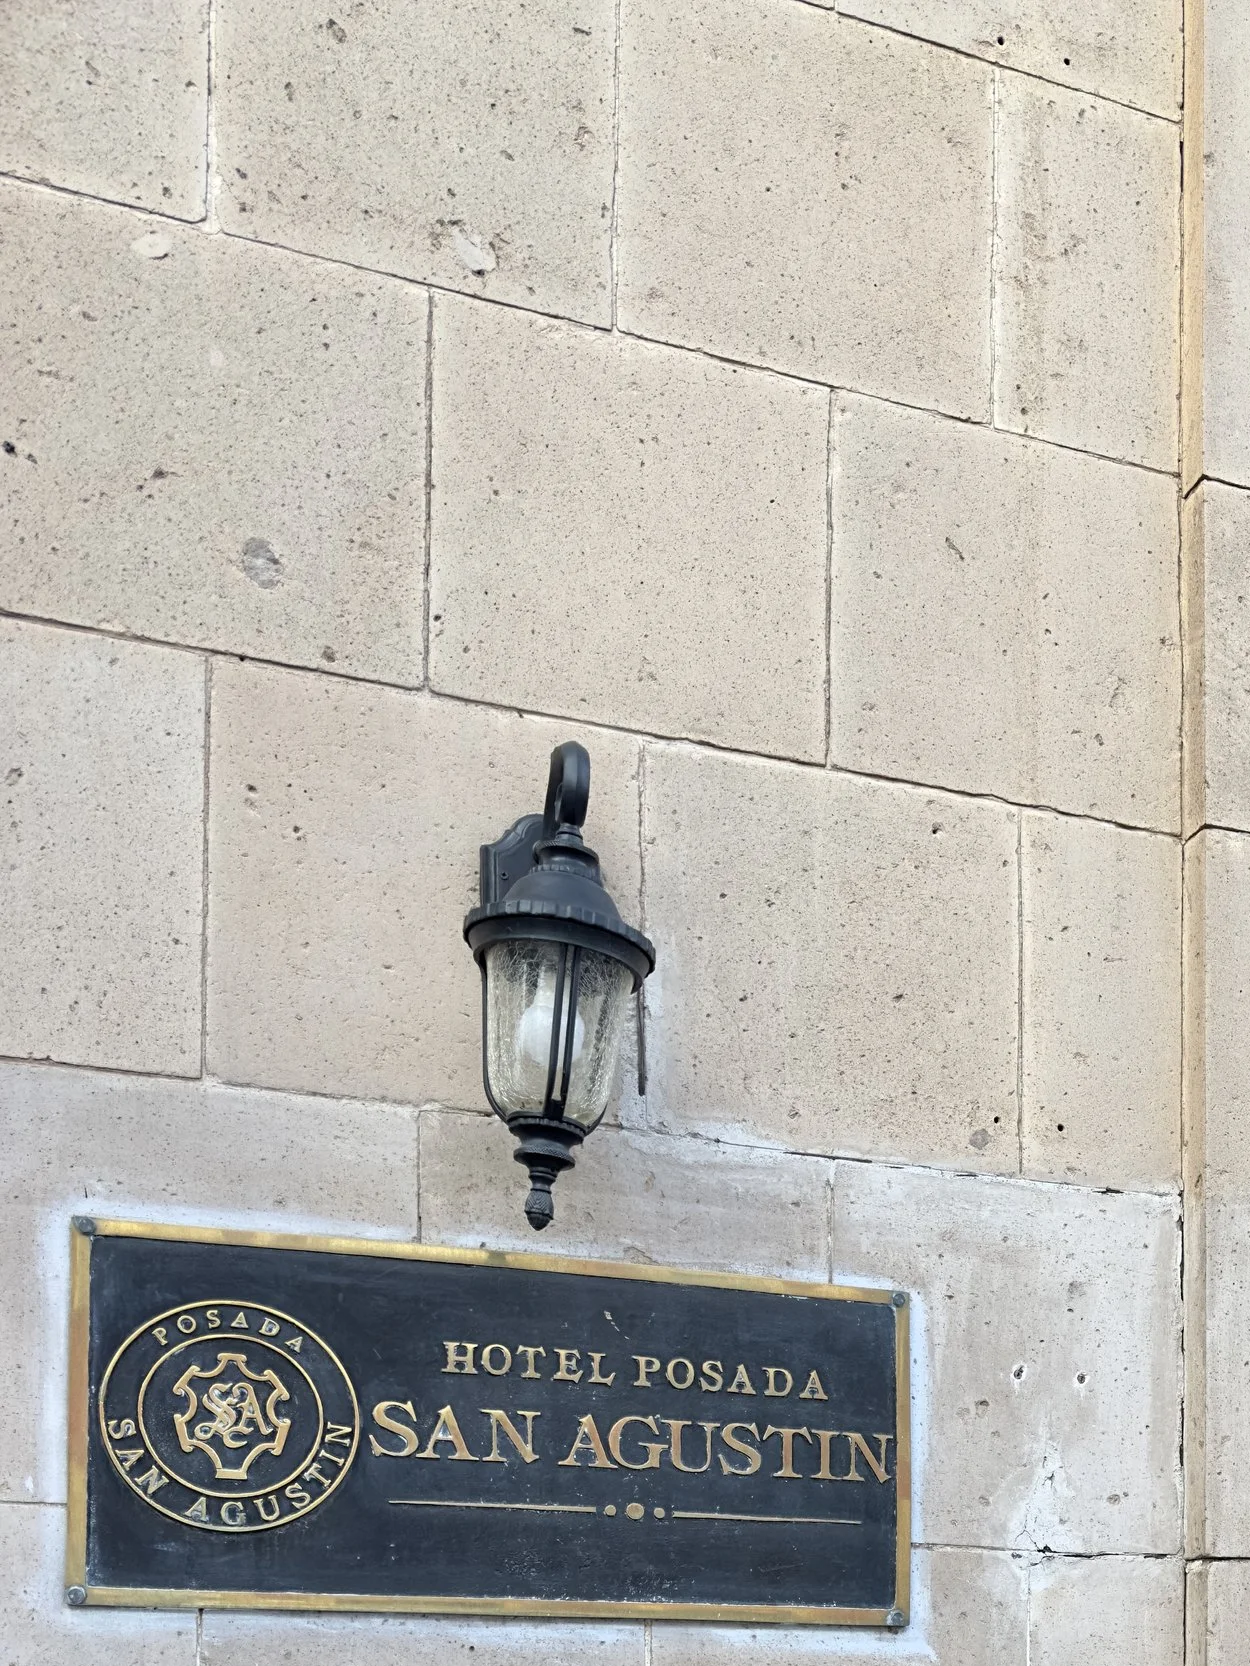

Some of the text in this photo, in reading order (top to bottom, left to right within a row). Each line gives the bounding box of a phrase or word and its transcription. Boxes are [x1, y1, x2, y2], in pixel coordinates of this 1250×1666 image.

[152, 1310, 304, 1353] POSADA
[441, 1341, 828, 1400] HOTEL POSADA
[108, 1419, 353, 1526] SAN AGUSTIN
[368, 1400, 893, 1484] SAN AGUSTIN
